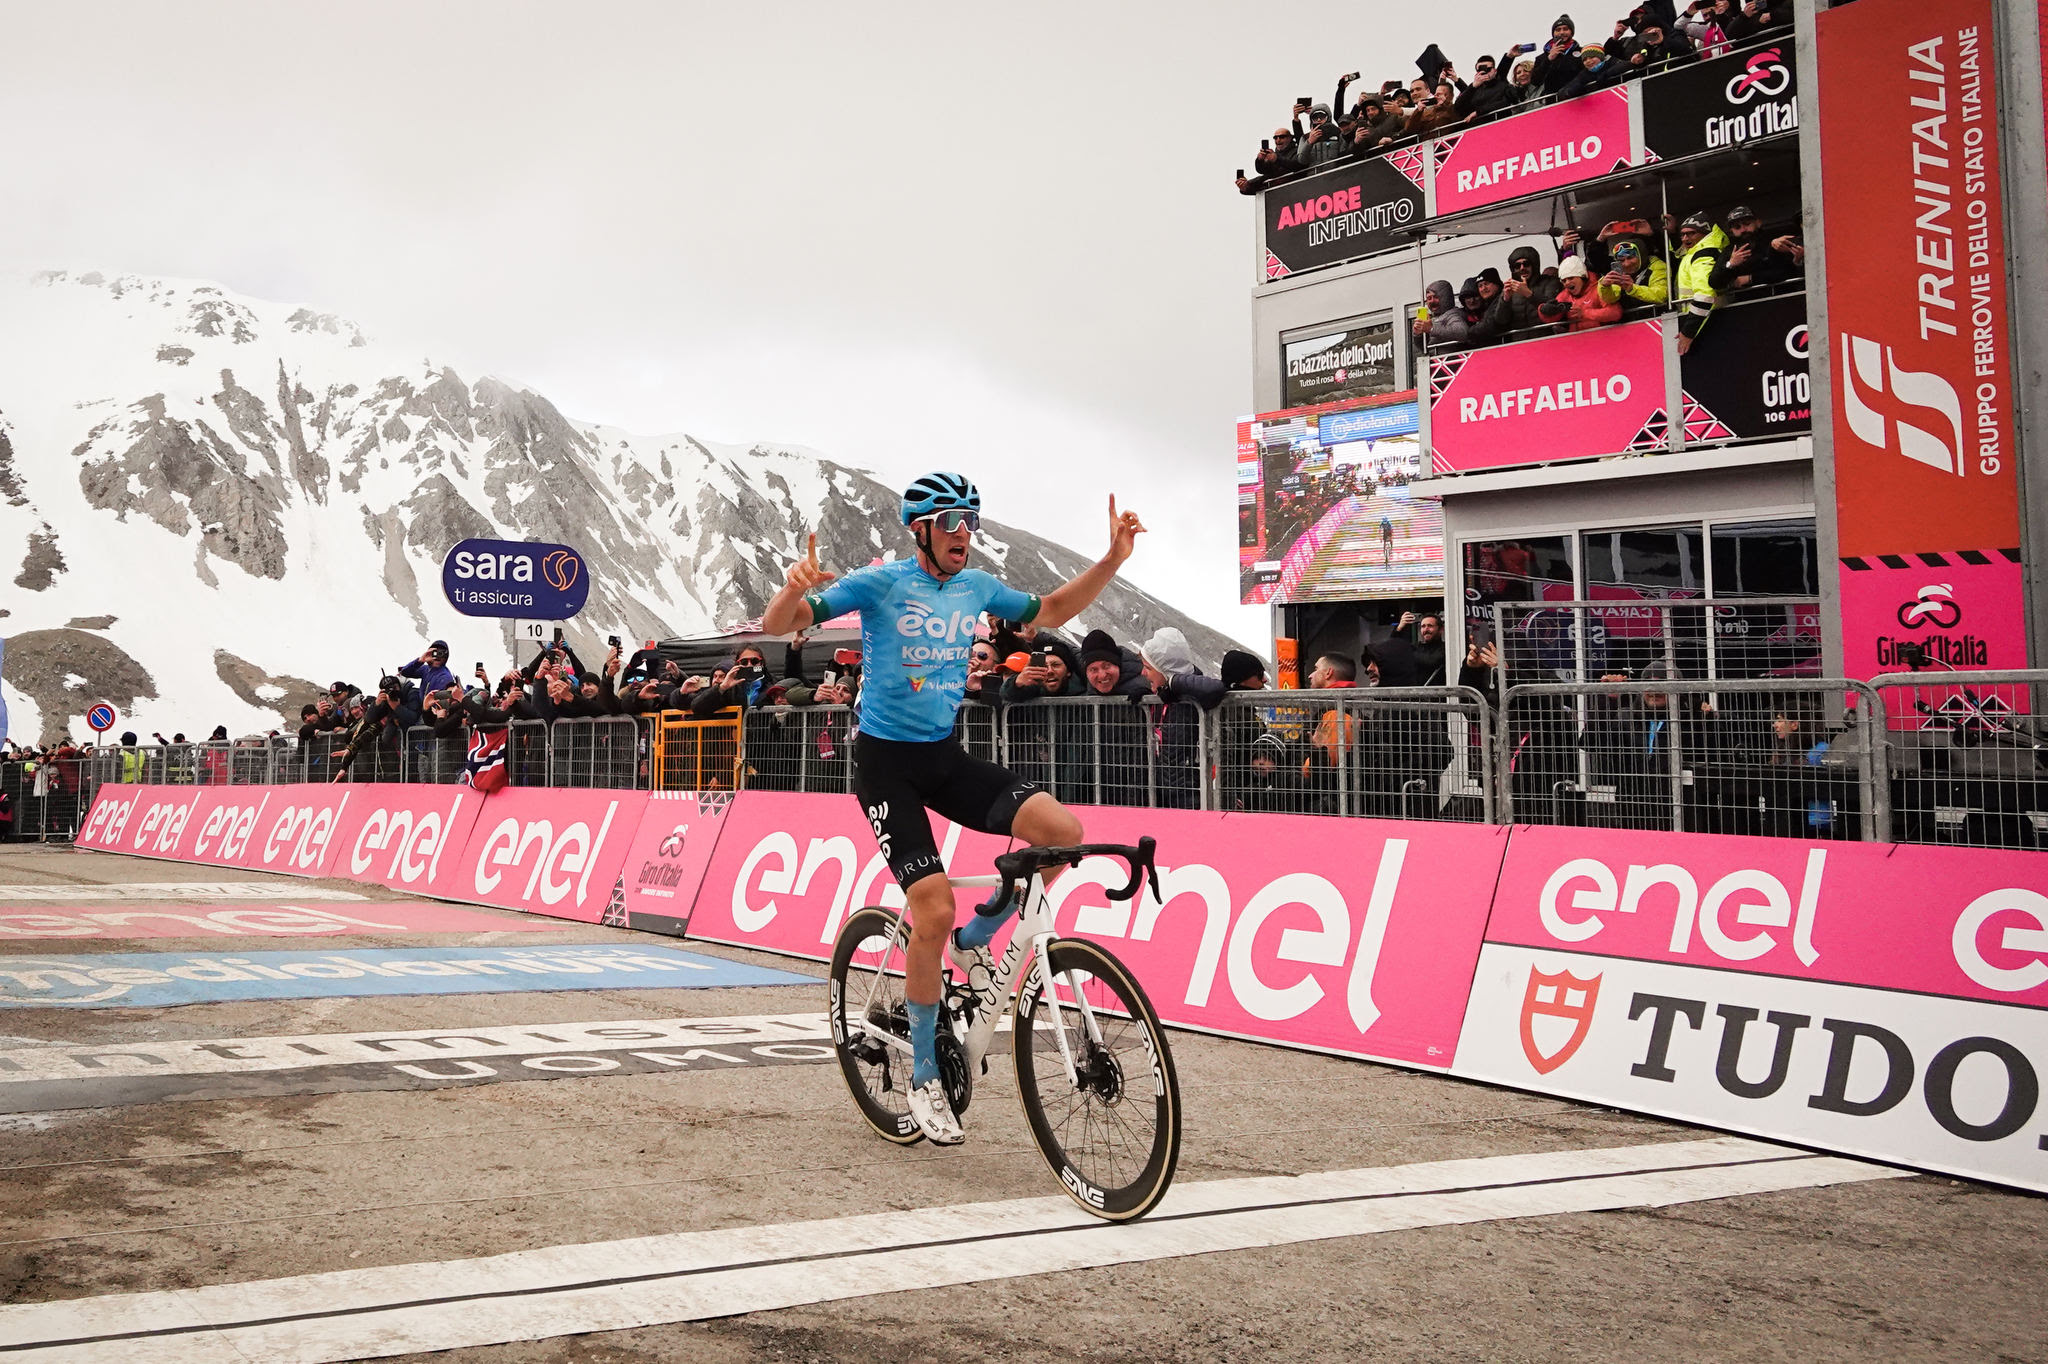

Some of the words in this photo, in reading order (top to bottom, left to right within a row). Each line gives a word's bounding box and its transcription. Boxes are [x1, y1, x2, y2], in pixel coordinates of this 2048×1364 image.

[1958, 26, 1982, 122] ITALIANE
[1705, 115, 1746, 148] Giro
[1749, 95, 1799, 138] d'Ital
[1456, 135, 1602, 193] RAFFAELLO
[1963, 127, 1986, 195] STATO
[1277, 185, 1361, 231] AMORE
[1908, 36, 1957, 341] TRENITALIA
[1308, 197, 1414, 247] INFINITO
[1967, 199, 1989, 268] DELLO
[1970, 273, 1995, 376] FERROVIE
[1299, 350, 1340, 375] Gazzetta
[1340, 345, 1363, 366] dello
[1363, 339, 1393, 365] Sport
[1348, 370, 1363, 379] della
[1364, 368, 1377, 376] vita
[1460, 374, 1632, 424] RAFFAELLO
[1762, 369, 1811, 408] Giro
[1764, 411, 1786, 423] 106
[1788, 408, 1813, 421] AM
[1976, 382, 2000, 476] GRUPPO
[454, 551, 533, 582] sara
[454, 587, 465, 602] ti
[469, 589, 533, 606] assicura
[527, 624, 543, 637] 10
[896, 610, 977, 644] eolo
[901, 645, 970, 662] KOMETA
[1876, 635, 1921, 666] Gir
[85, 789, 142, 845] enel
[134, 791, 201, 853] enel
[194, 791, 270, 860] enel
[263, 791, 350, 869] enel
[351, 793, 463, 885] enel
[474, 801, 619, 908] enel
[0, 905, 408, 936] enel
[1539, 848, 1827, 967] enel
[393, 1044, 838, 1081] UOMO
[1628, 991, 2048, 1150] TUDO
